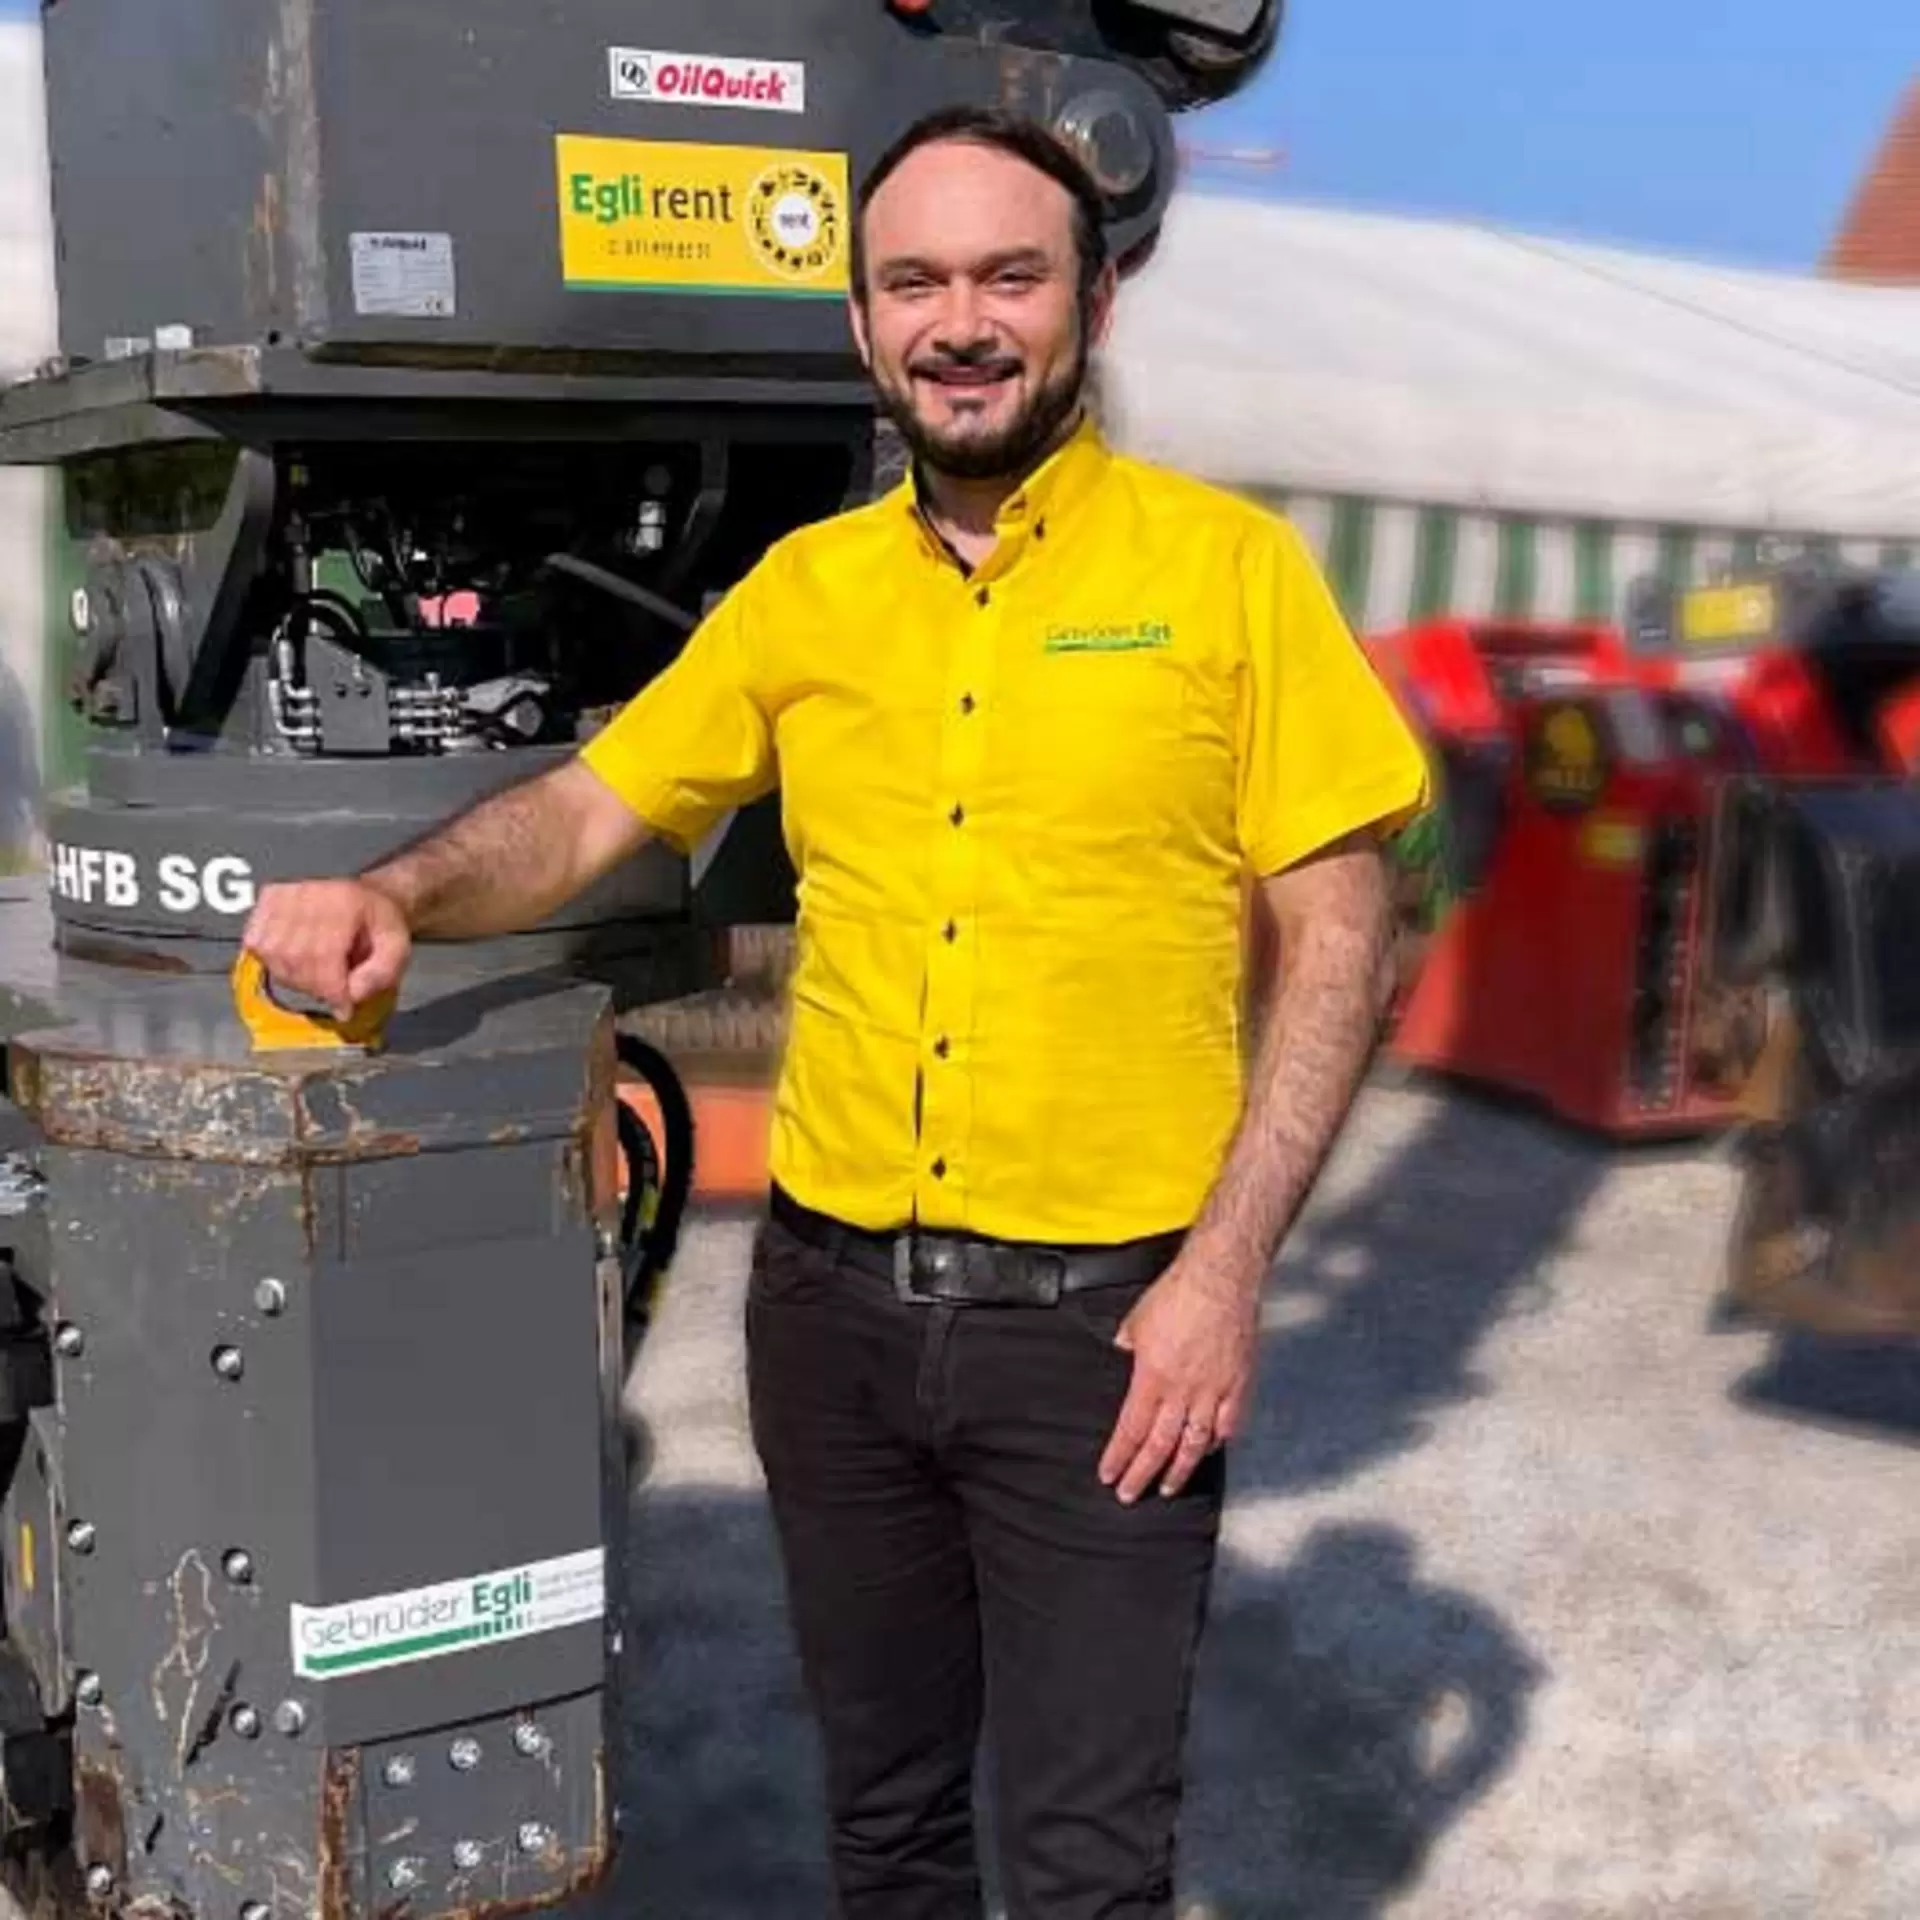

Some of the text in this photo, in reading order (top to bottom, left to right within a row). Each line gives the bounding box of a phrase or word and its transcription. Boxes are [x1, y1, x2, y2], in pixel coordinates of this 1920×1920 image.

[656, 64, 786, 103] OilQuick
[570, 173, 643, 224] Egli
[652, 185, 733, 223] rent
[157, 854, 256, 914] SG
[471, 1571, 532, 1616] Egli
